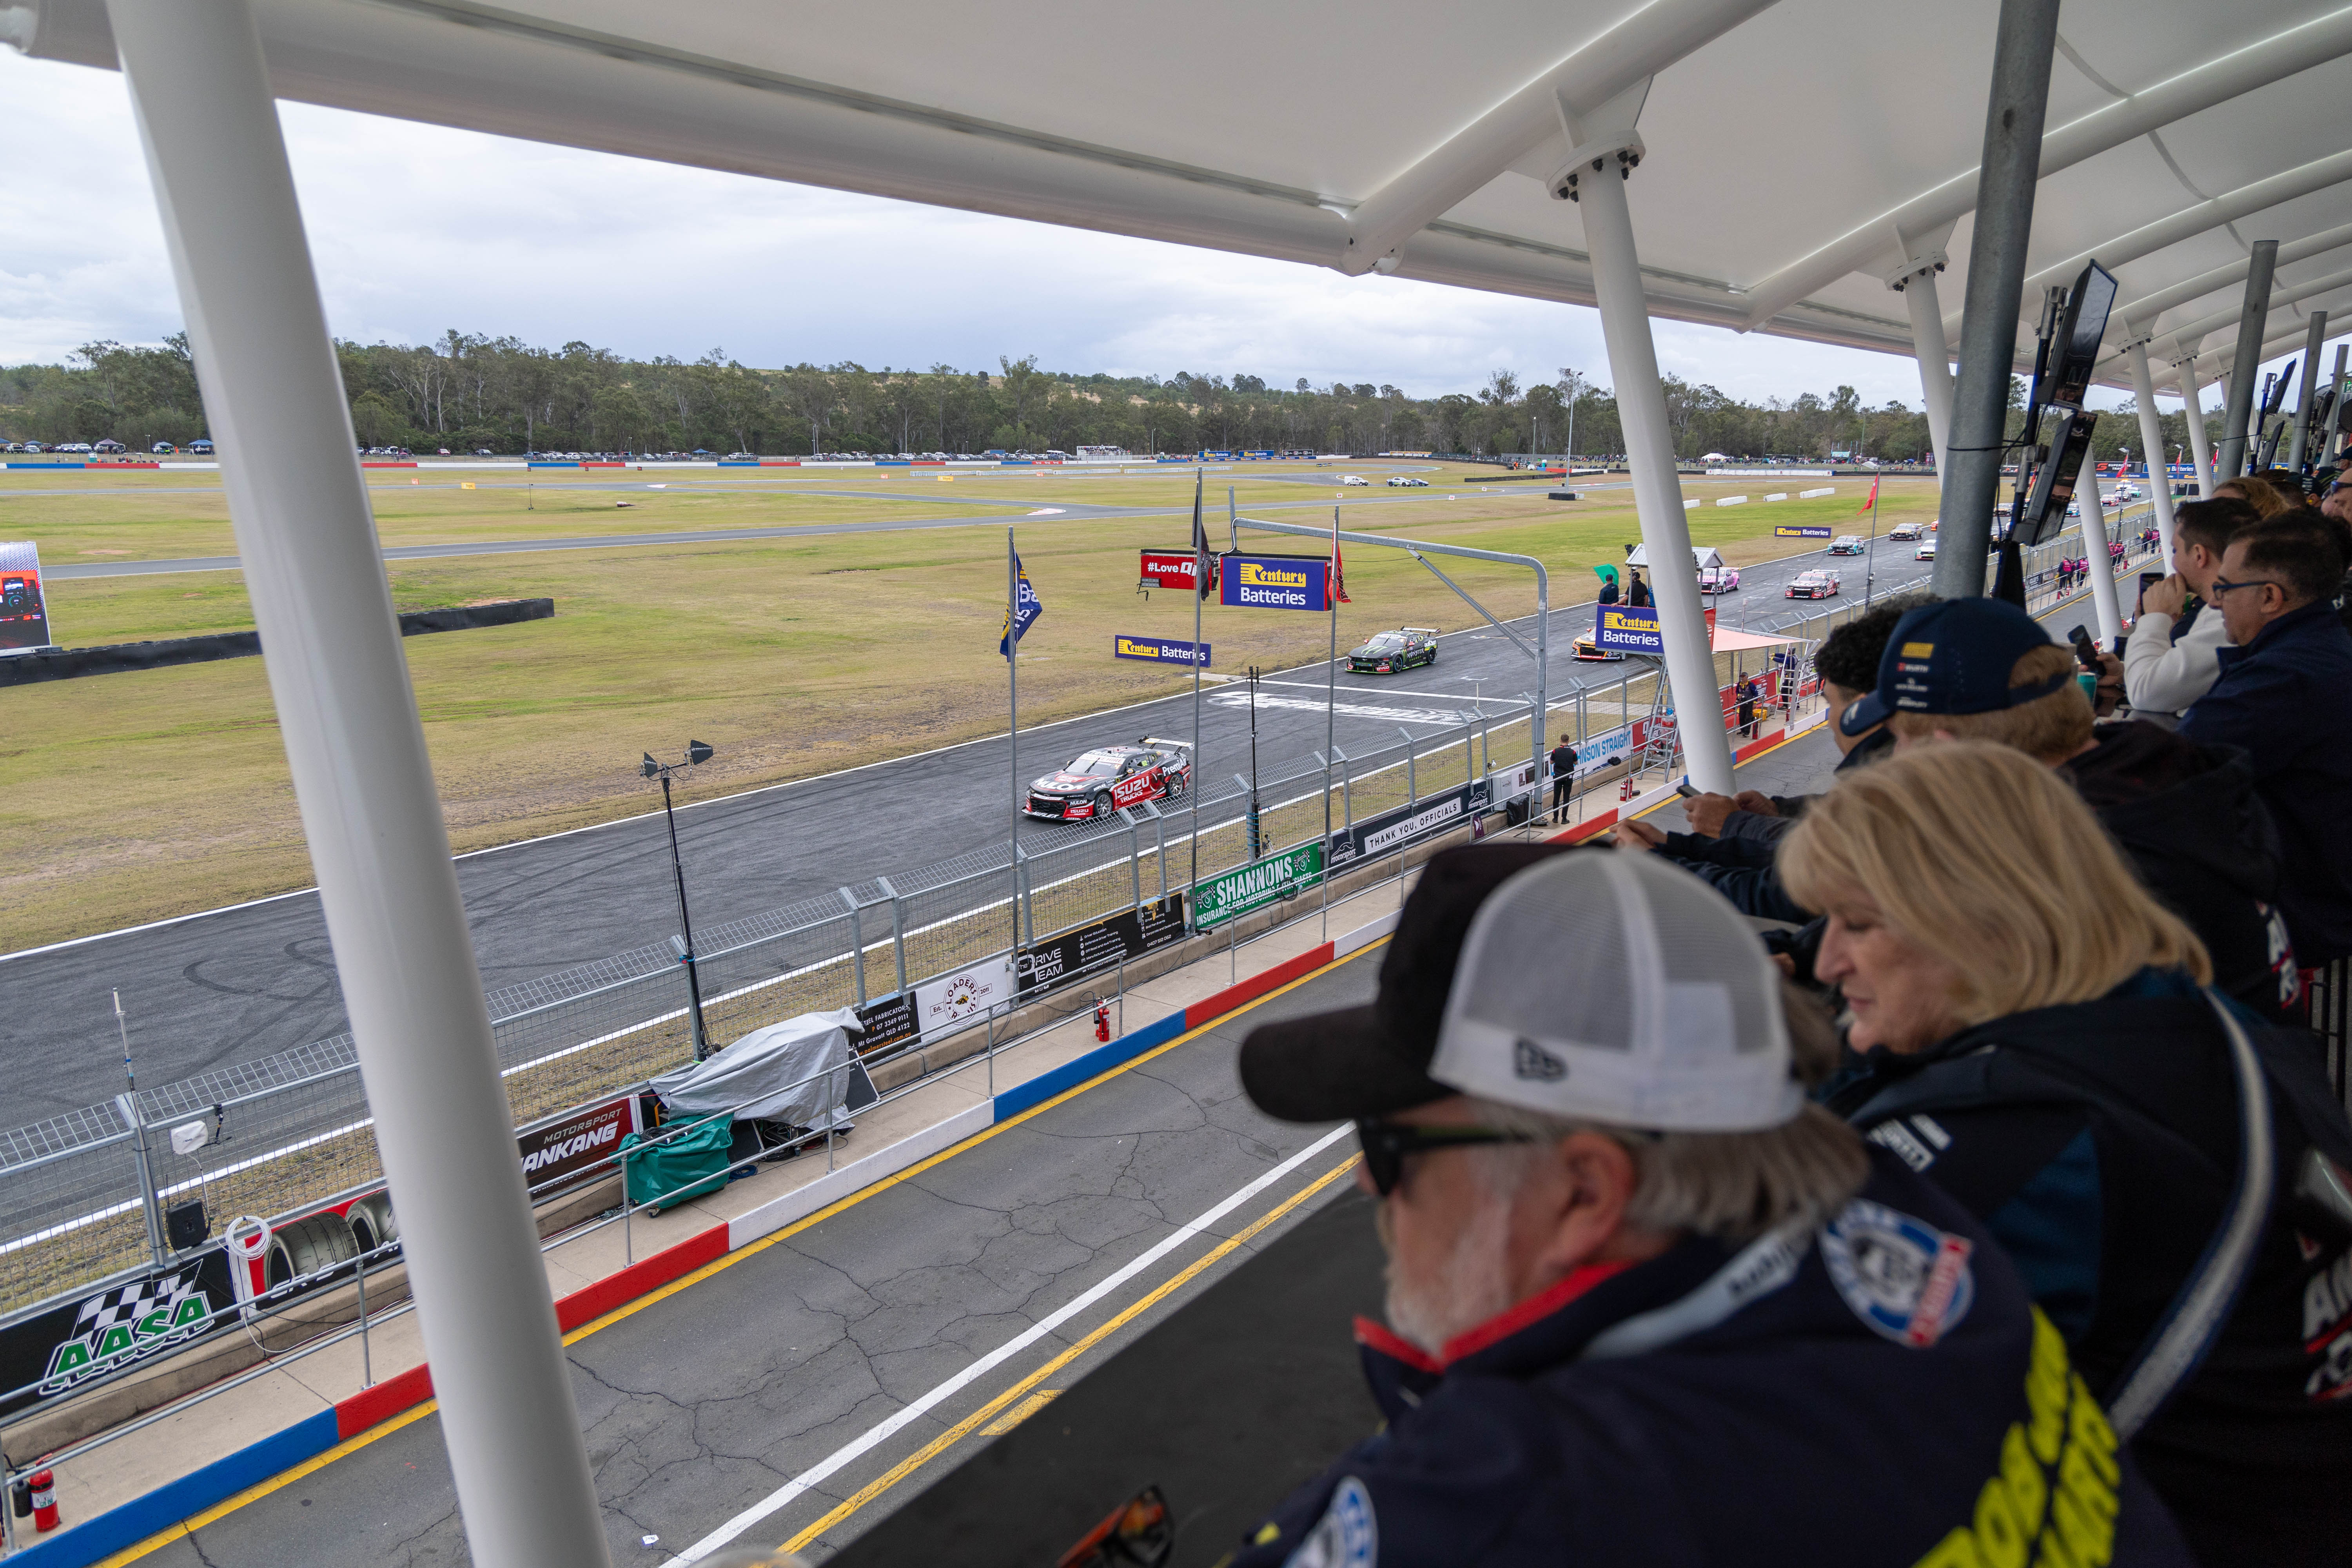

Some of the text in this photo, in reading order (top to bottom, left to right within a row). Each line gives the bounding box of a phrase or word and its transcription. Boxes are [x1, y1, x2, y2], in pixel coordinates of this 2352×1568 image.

[1147, 562, 1179, 573] #Love
[1240, 563, 1306, 587] Century
[1241, 587, 1306, 606] Batteries
[1604, 612, 1660, 632] Century
[1118, 639, 1159, 657] Century
[1603, 630, 1659, 646] Batteries
[1407, 648, 1425, 659] MONSTER
[1573, 731, 1631, 767] HNSON STRAIGHT
[1162, 757, 1187, 777] PremiAir
[1035, 778, 1092, 791] NULON
[1114, 776, 1150, 800] ISUZU
[1120, 789, 1143, 803] TRUCKS
[1468, 798, 1488, 810] motorsport
[1370, 830, 1396, 848] THANK
[1399, 821, 1417, 835] YOU,
[1420, 803, 1457, 826] OFFICIALS
[1330, 849, 1356, 864] motorsport
[1216, 856, 1292, 906] SHANNONS
[1196, 903, 1232, 926] INSURANCE
[1086, 950, 1105, 960] Manufacturer
[946, 978, 977, 1004] LOADERS
[875, 1004, 909, 1021] FABRICATORS
[884, 1018, 897, 1027] 3349
[898, 1013, 909, 1022] 9111
[866, 1033, 885, 1044] Gravatt
[886, 1027, 896, 1036] QLD
[897, 1022, 910, 1031] 4122
[544, 1107, 622, 1145] MOTORSPORT
[521, 1121, 619, 1174] ANKANG
[40, 1291, 215, 1396] AASA
